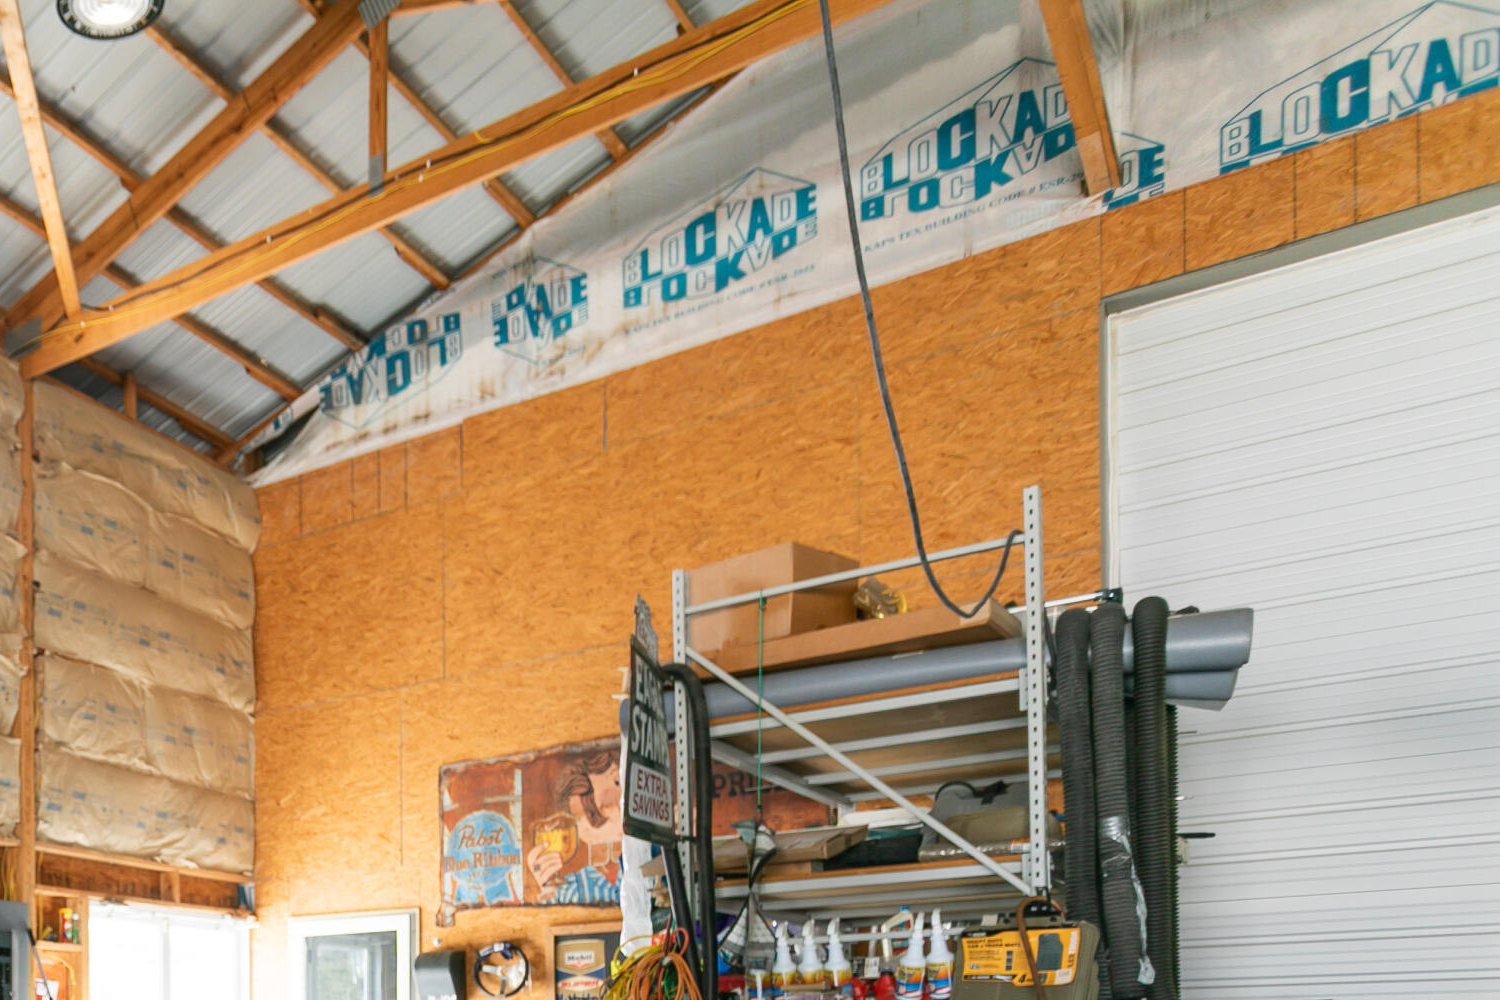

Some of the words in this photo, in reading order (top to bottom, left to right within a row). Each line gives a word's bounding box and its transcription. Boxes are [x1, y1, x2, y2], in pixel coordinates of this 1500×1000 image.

[1220, 27, 1500, 166] BLOCKAD
[861, 83, 1073, 200] BLOCKAD
[623, 184, 817, 290] BLOCKADE
[636, 769, 667, 798] EXTRA
[632, 792, 670, 822] SAVINGS
[458, 825, 503, 849] Pabst
[444, 856, 470, 873] Blue
[472, 850, 520, 869] Ribbon
